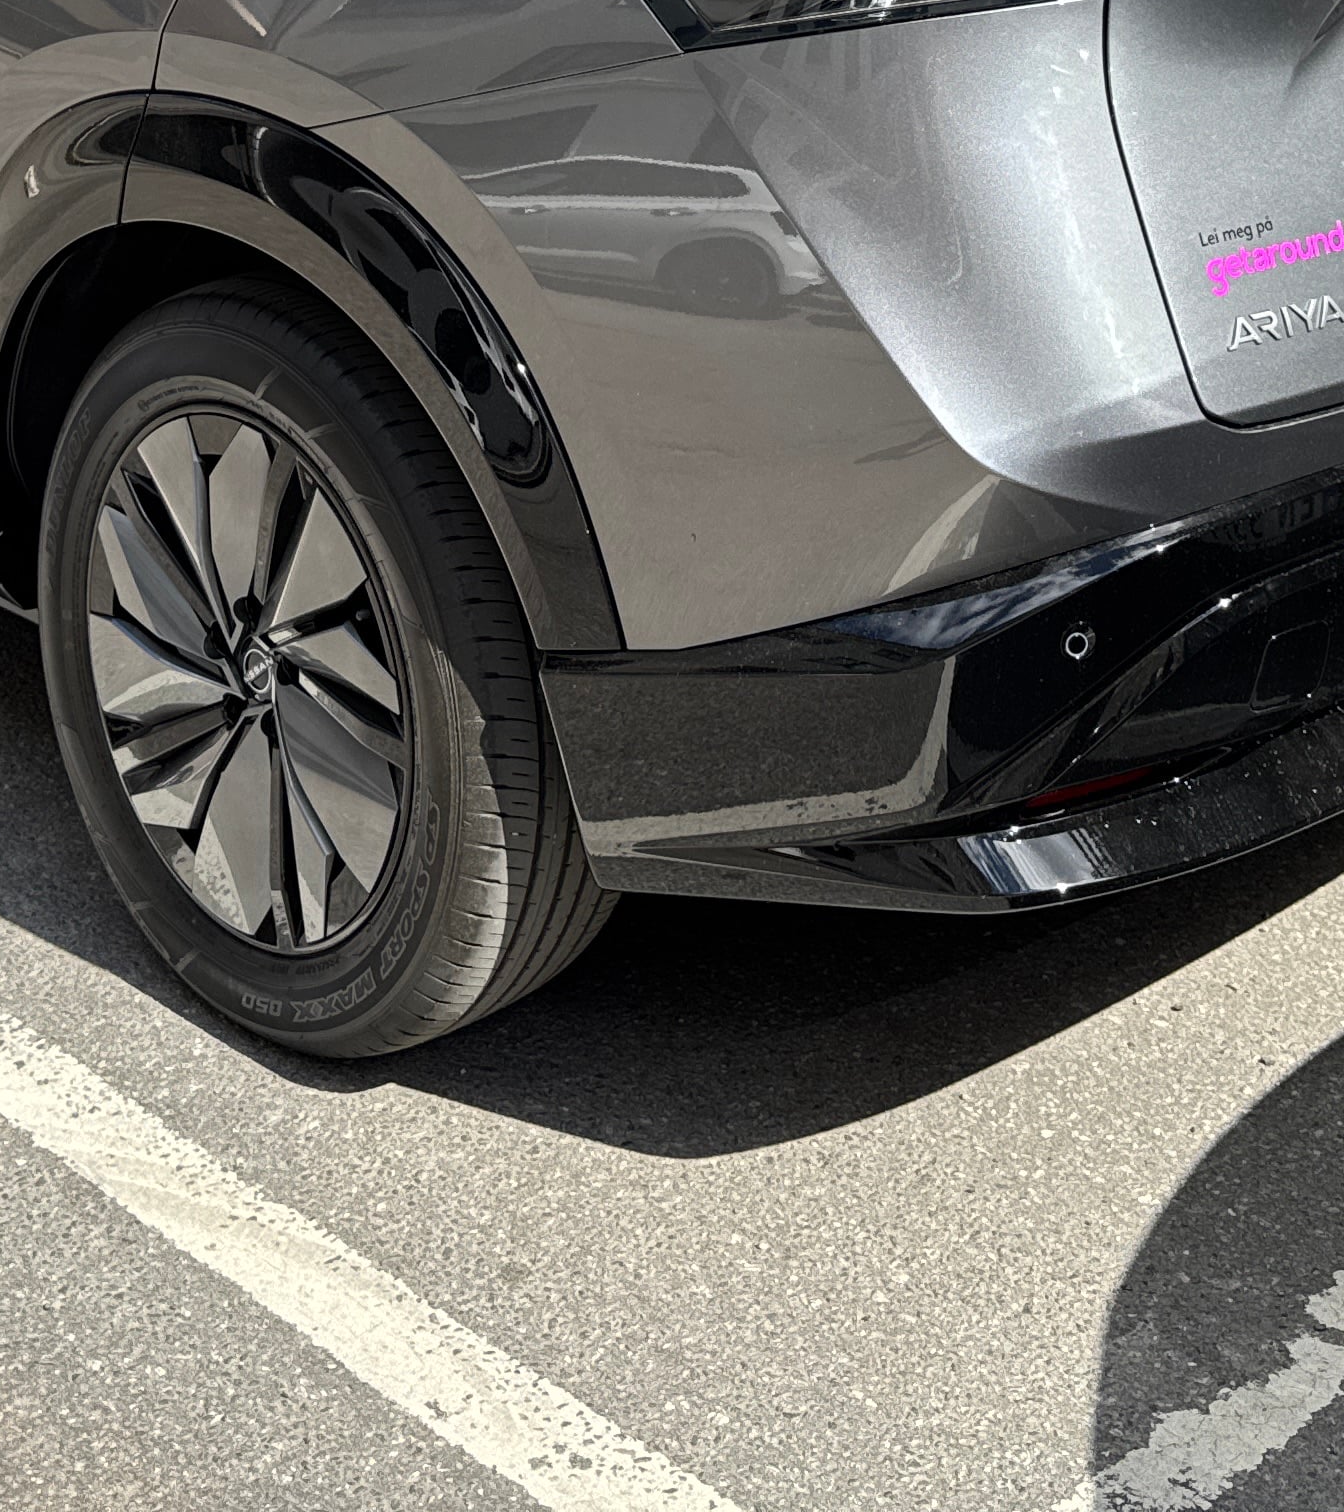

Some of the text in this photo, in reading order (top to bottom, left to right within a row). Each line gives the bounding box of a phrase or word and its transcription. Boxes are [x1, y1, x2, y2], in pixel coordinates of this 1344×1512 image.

[1198, 215, 1274, 247] Lei meg på
[380, 856, 432, 981] SPORT
[288, 966, 378, 1023] MAXX
